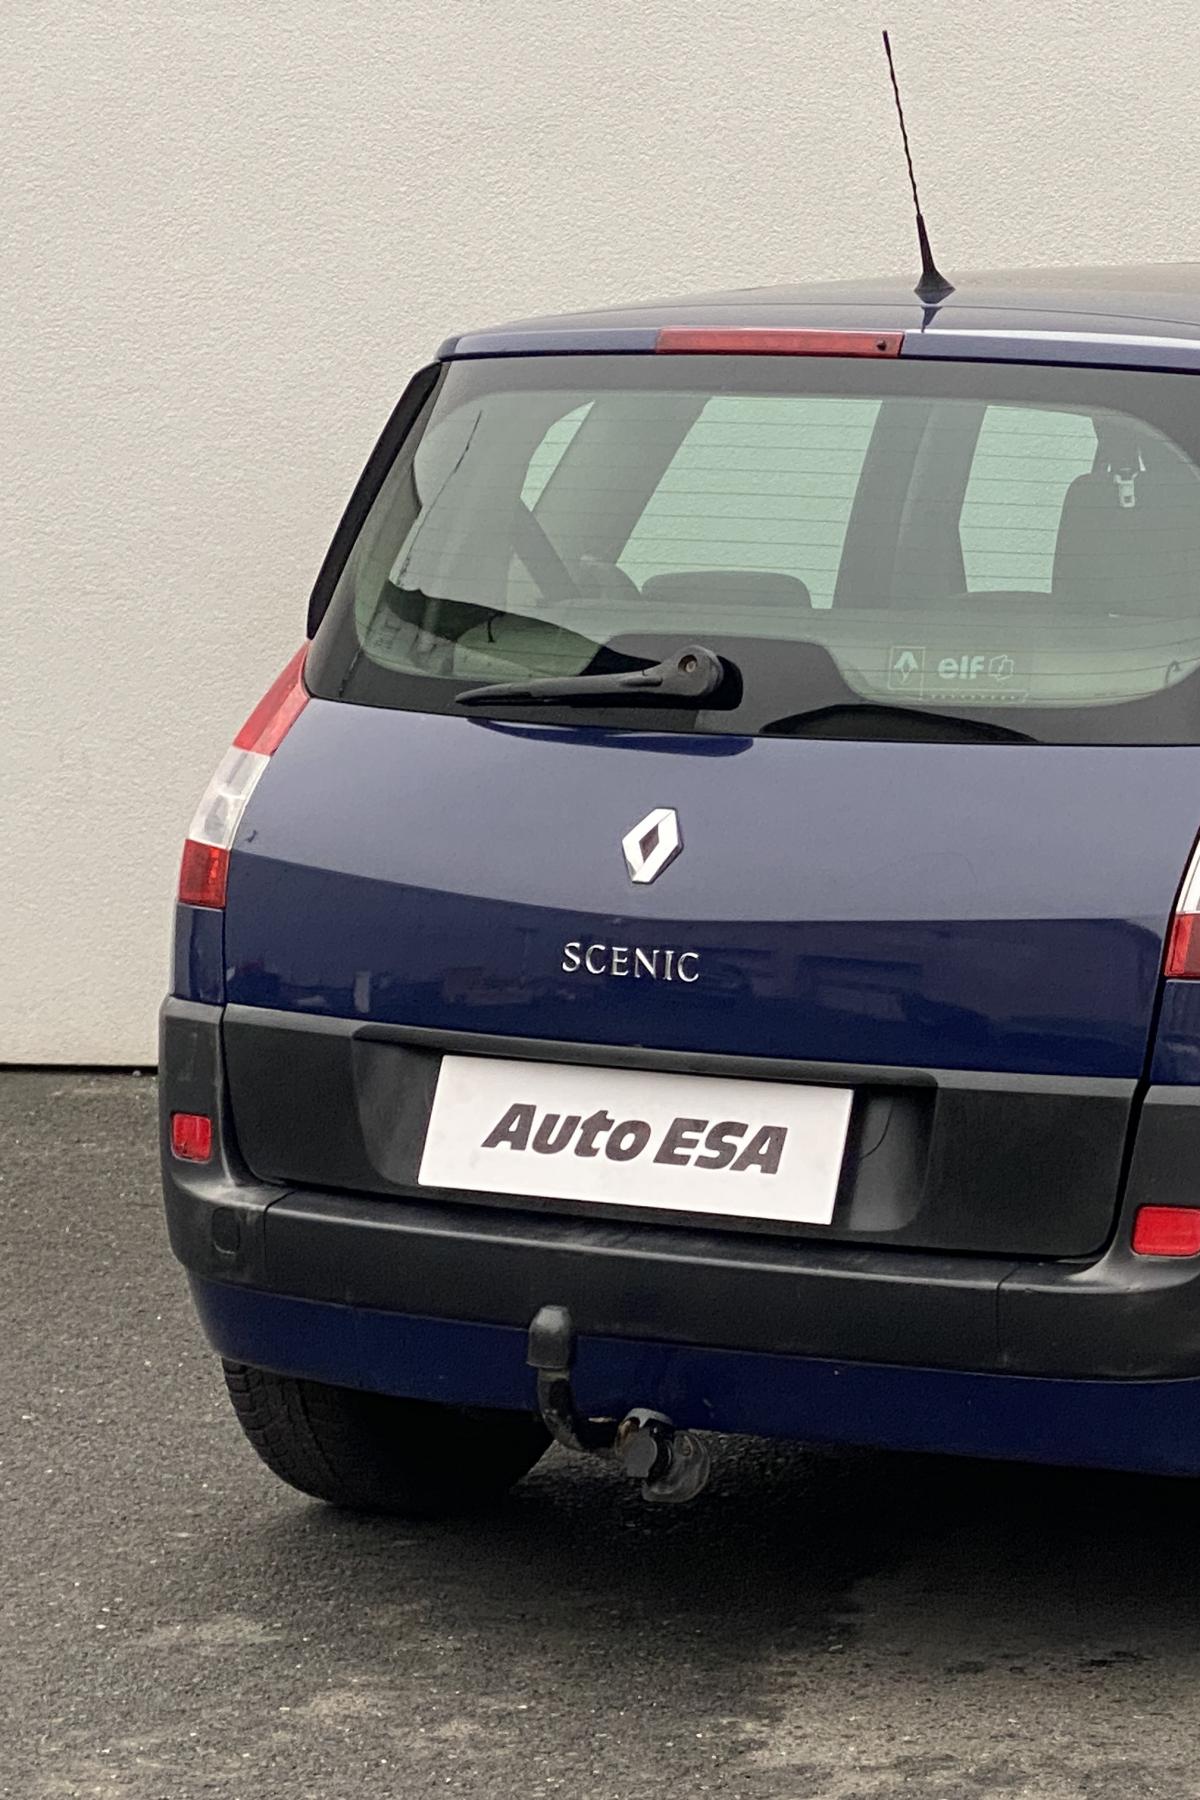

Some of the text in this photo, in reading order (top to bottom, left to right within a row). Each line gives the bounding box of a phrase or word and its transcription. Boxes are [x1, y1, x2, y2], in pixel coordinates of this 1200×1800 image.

[937, 654, 985, 681] elf
[561, 942, 699, 982] SCENIC
[480, 1102, 789, 1175] Auto ESA
